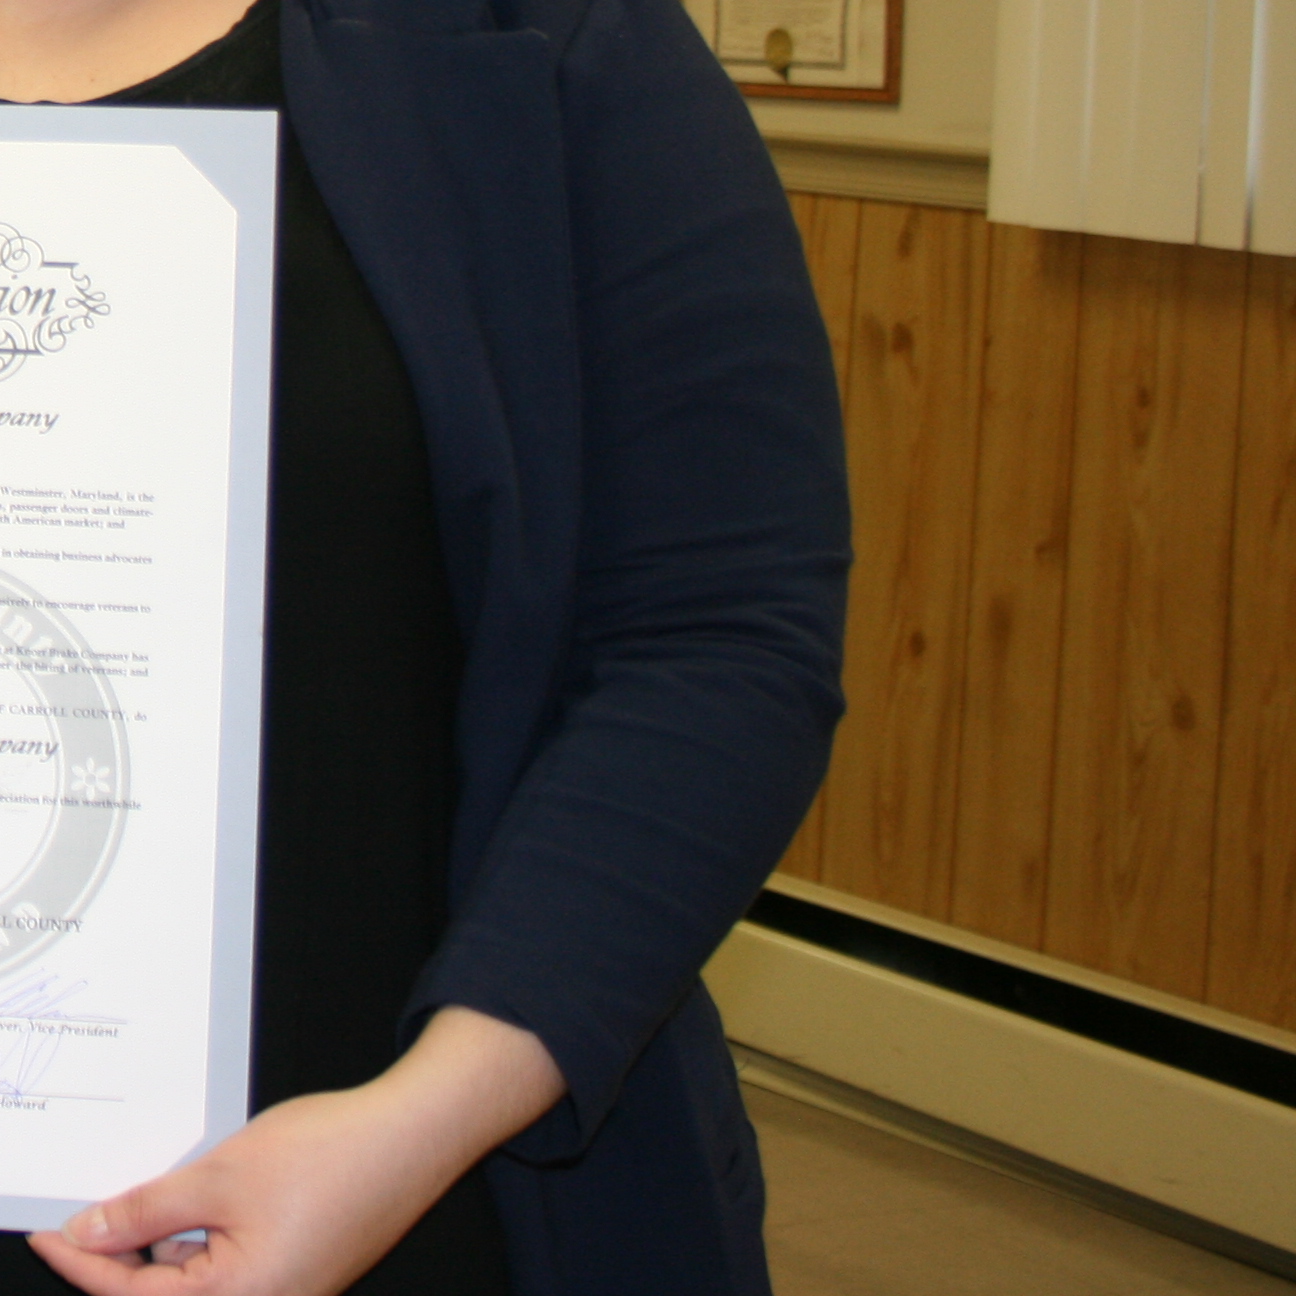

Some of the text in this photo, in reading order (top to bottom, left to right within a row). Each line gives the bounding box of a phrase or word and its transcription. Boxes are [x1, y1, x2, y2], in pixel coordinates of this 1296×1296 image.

[8, 704, 67, 717] CARROLL
[72, 708, 129, 720] COUNTY,
[15, 914, 82, 930] COUNTY
